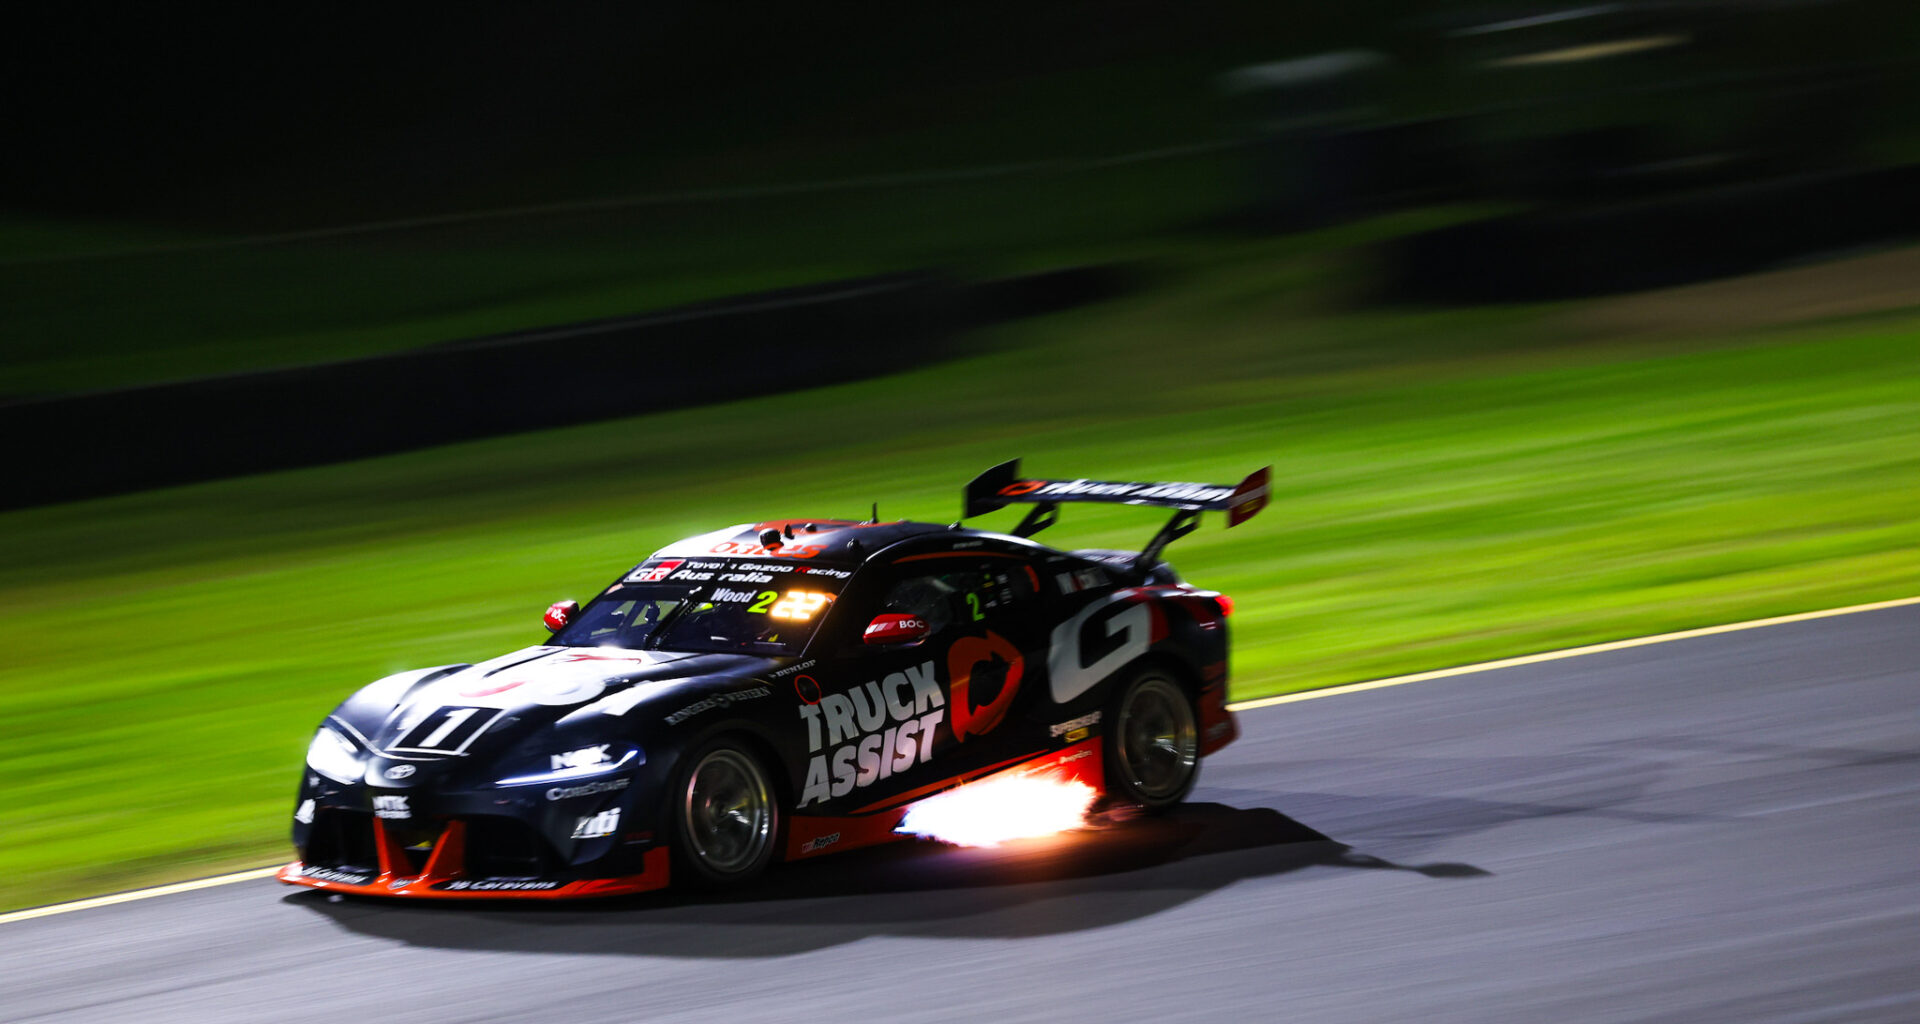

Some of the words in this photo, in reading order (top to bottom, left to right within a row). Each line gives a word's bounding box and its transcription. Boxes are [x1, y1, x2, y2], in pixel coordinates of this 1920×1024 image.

[670, 569, 774, 583] Ausralia
[685, 561, 737, 571] TOYO
[738, 563, 794, 573] GAZOO
[794, 566, 852, 579] Racing
[710, 588, 757, 603] Wood
[747, 590, 778, 614] 2
[770, 589, 828, 621] 22
[966, 592, 986, 622] 2
[899, 620, 925, 629] BOC
[776, 659, 817, 678] DUNLOP
[798, 660, 945, 753] TRUCK
[796, 709, 945, 809] ASSIST
